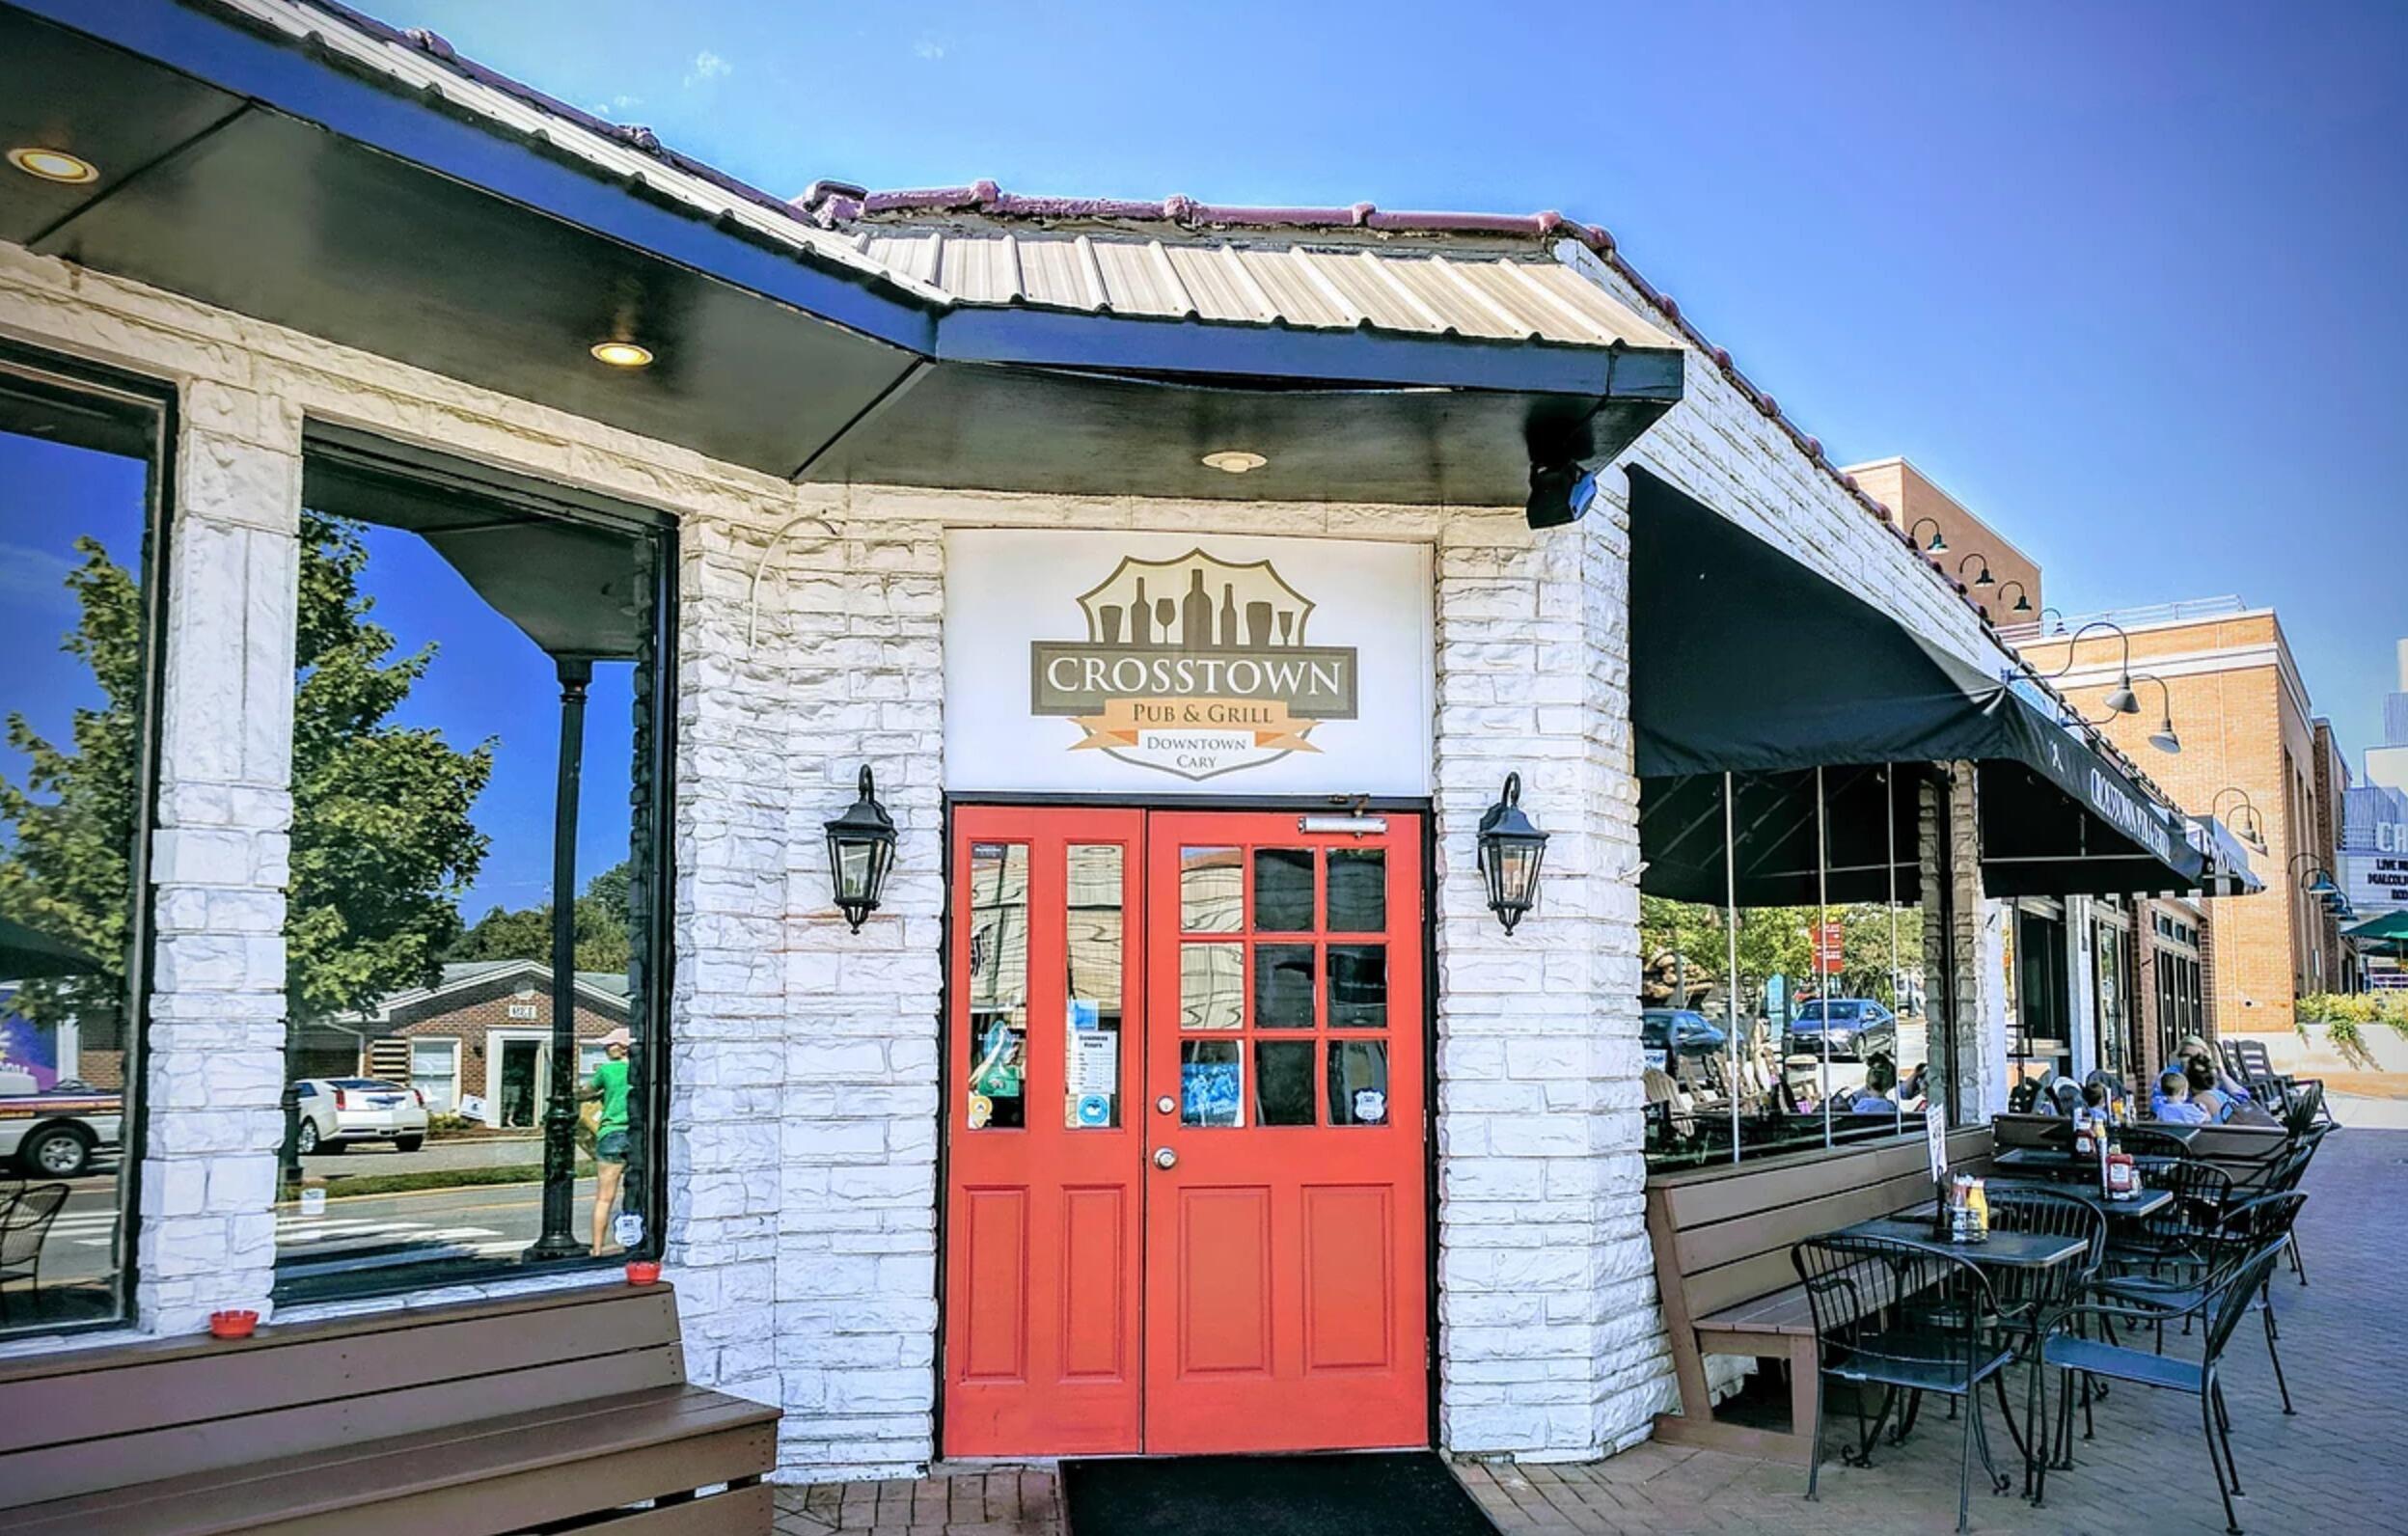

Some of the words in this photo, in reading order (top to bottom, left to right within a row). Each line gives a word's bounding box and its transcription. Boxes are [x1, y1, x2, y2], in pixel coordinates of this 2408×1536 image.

[1047, 656, 1341, 696] CROSSTOWN
[1184, 703, 1201, 723] &
[1147, 736, 1246, 750] DOWNTOWN
[1176, 754, 1217, 769] CARY
